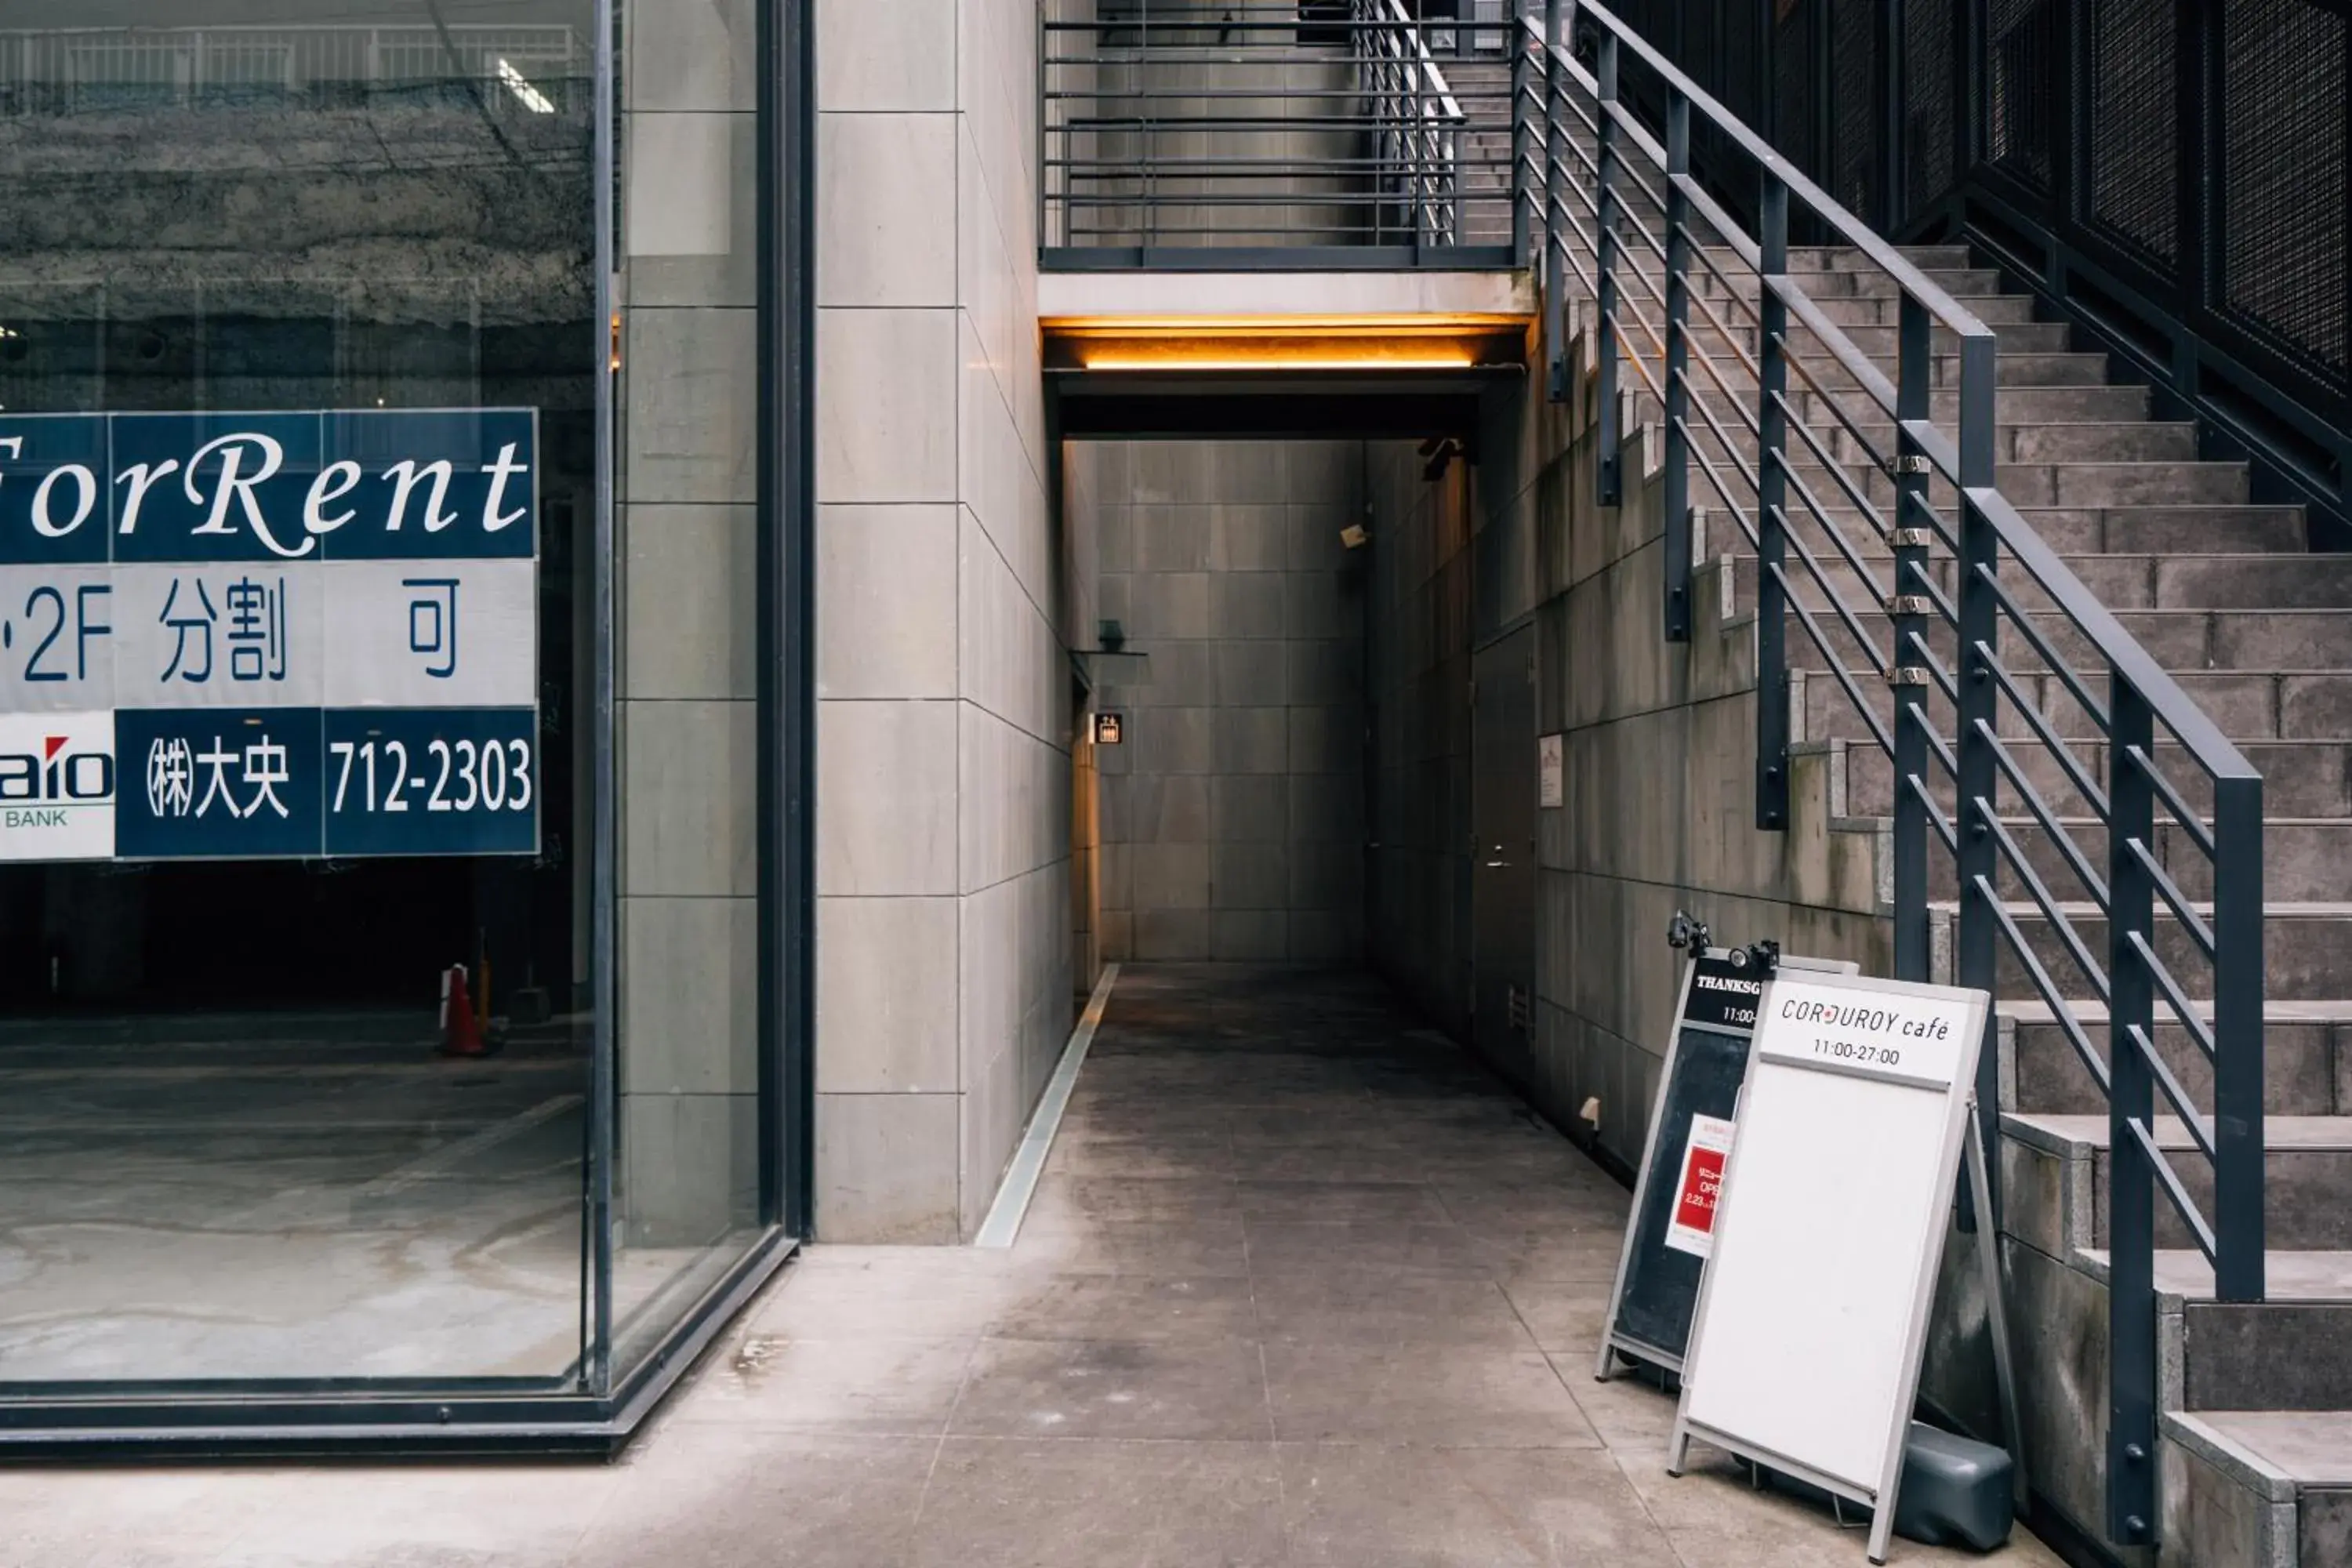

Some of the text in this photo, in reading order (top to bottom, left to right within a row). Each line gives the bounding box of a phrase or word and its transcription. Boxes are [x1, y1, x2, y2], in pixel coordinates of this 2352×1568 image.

[159, 576, 287, 682] 分割
[401, 578, 461, 678] 可
[329, 739, 532, 812] 712-2303
[5, 810, 67, 828] BANK
[1781, 1000, 1949, 1041] CORDUROY café
[1813, 1039, 1900, 1065] 11:00-27:00
